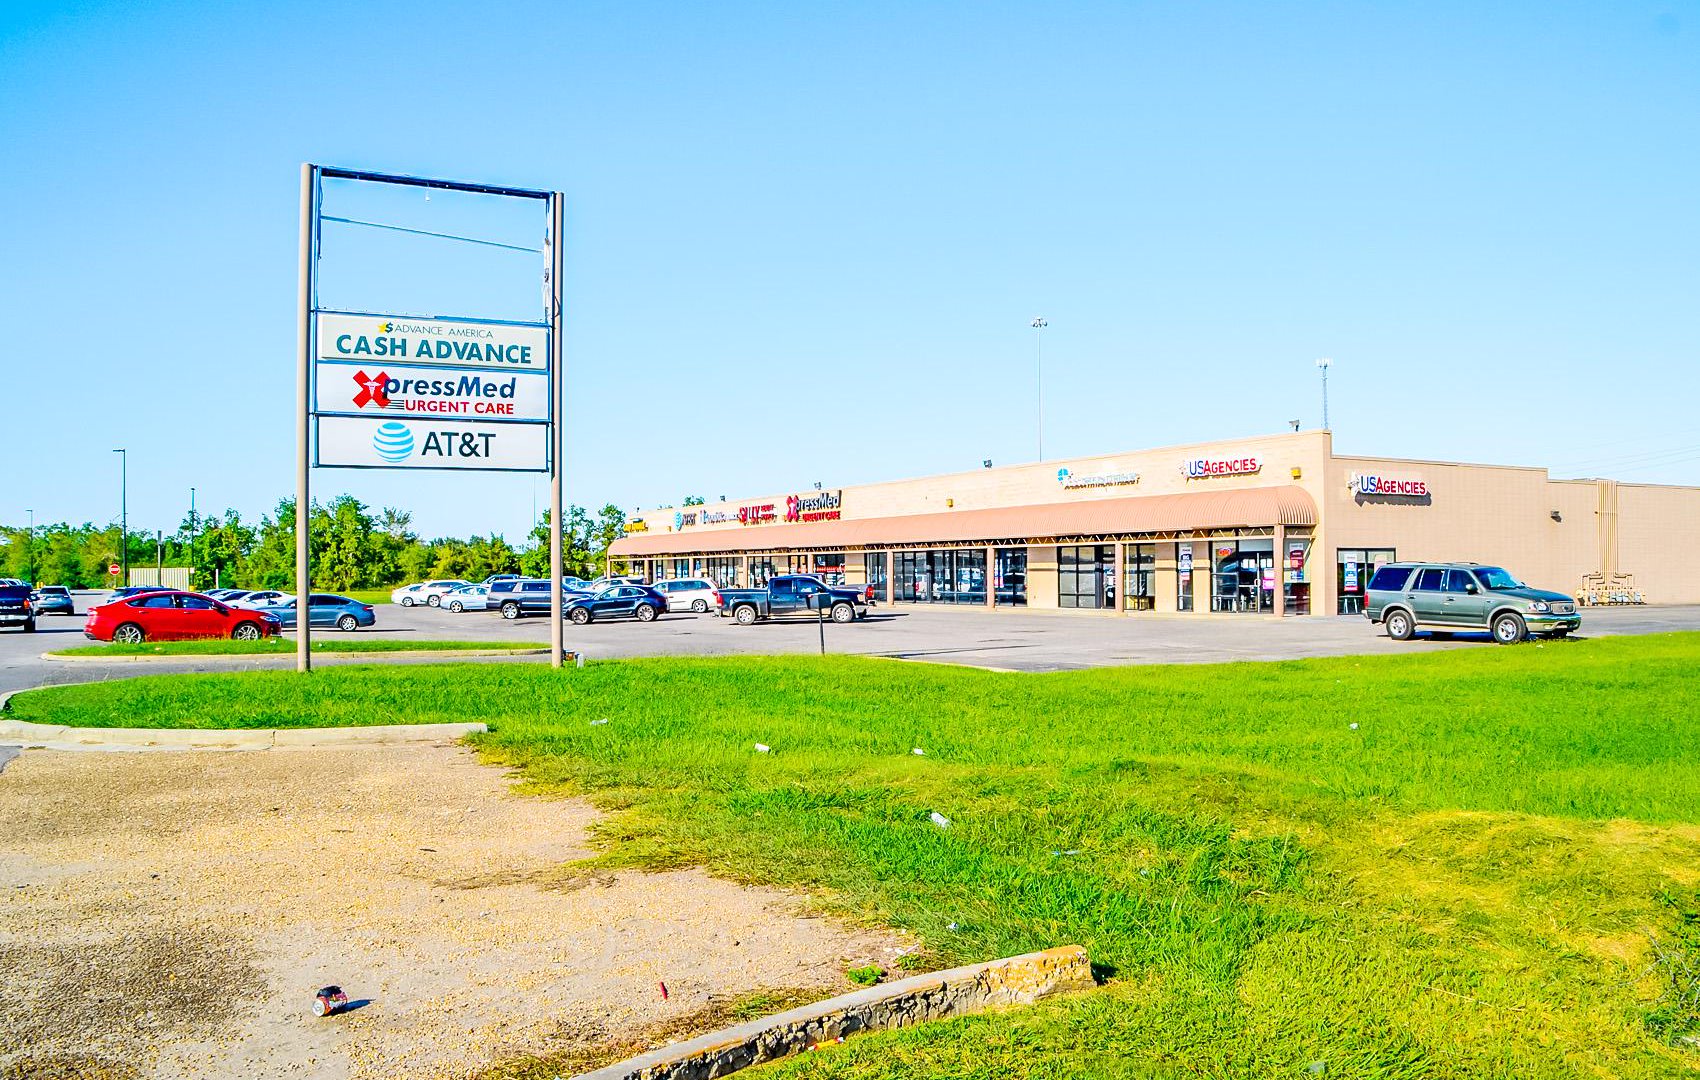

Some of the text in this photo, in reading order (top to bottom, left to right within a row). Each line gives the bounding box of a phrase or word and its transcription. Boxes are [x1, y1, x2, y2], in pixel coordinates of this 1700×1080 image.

[395, 324, 443, 336] ADVANCE
[448, 328, 493, 339] AMERICA
[336, 334, 532, 364] CASH ADVANCE
[405, 399, 514, 415] URGENT CARE
[421, 431, 497, 458] AT&T
[1189, 458, 1257, 476] USAGENCIES
[1361, 475, 1426, 495] USAGENCIES
